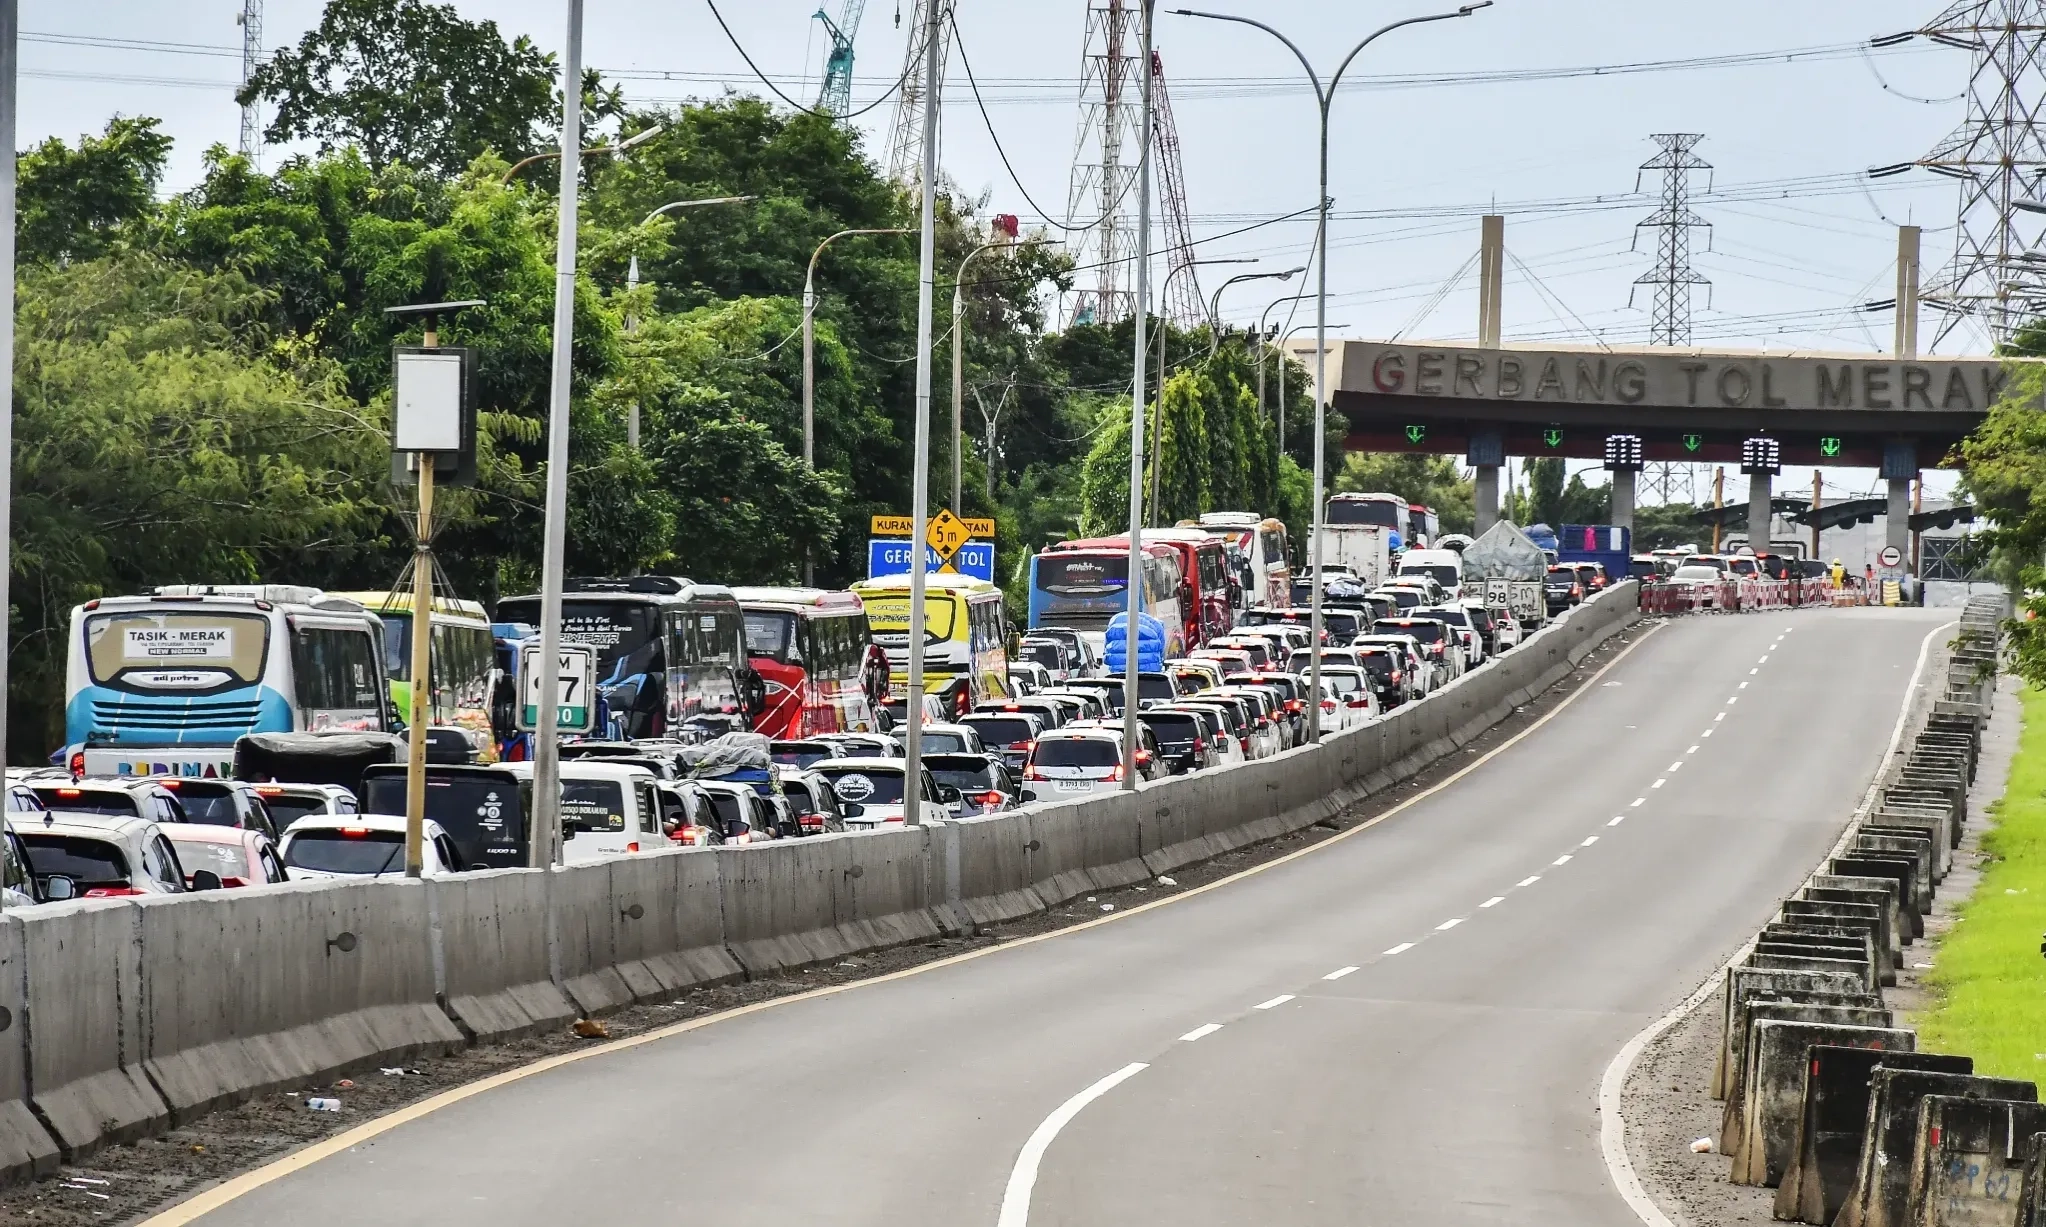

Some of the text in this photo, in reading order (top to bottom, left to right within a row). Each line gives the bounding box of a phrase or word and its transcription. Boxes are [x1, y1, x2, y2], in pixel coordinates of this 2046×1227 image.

[1372, 350, 2007, 409] GERBANG TOL MERAK
[936, 526, 957, 543] 5 m
[961, 551, 986, 567] TOL
[1488, 592, 1506, 603] 98
[129, 631, 168, 641] TASIK
[179, 631, 226, 641] MERAK
[559, 656, 570, 670] M
